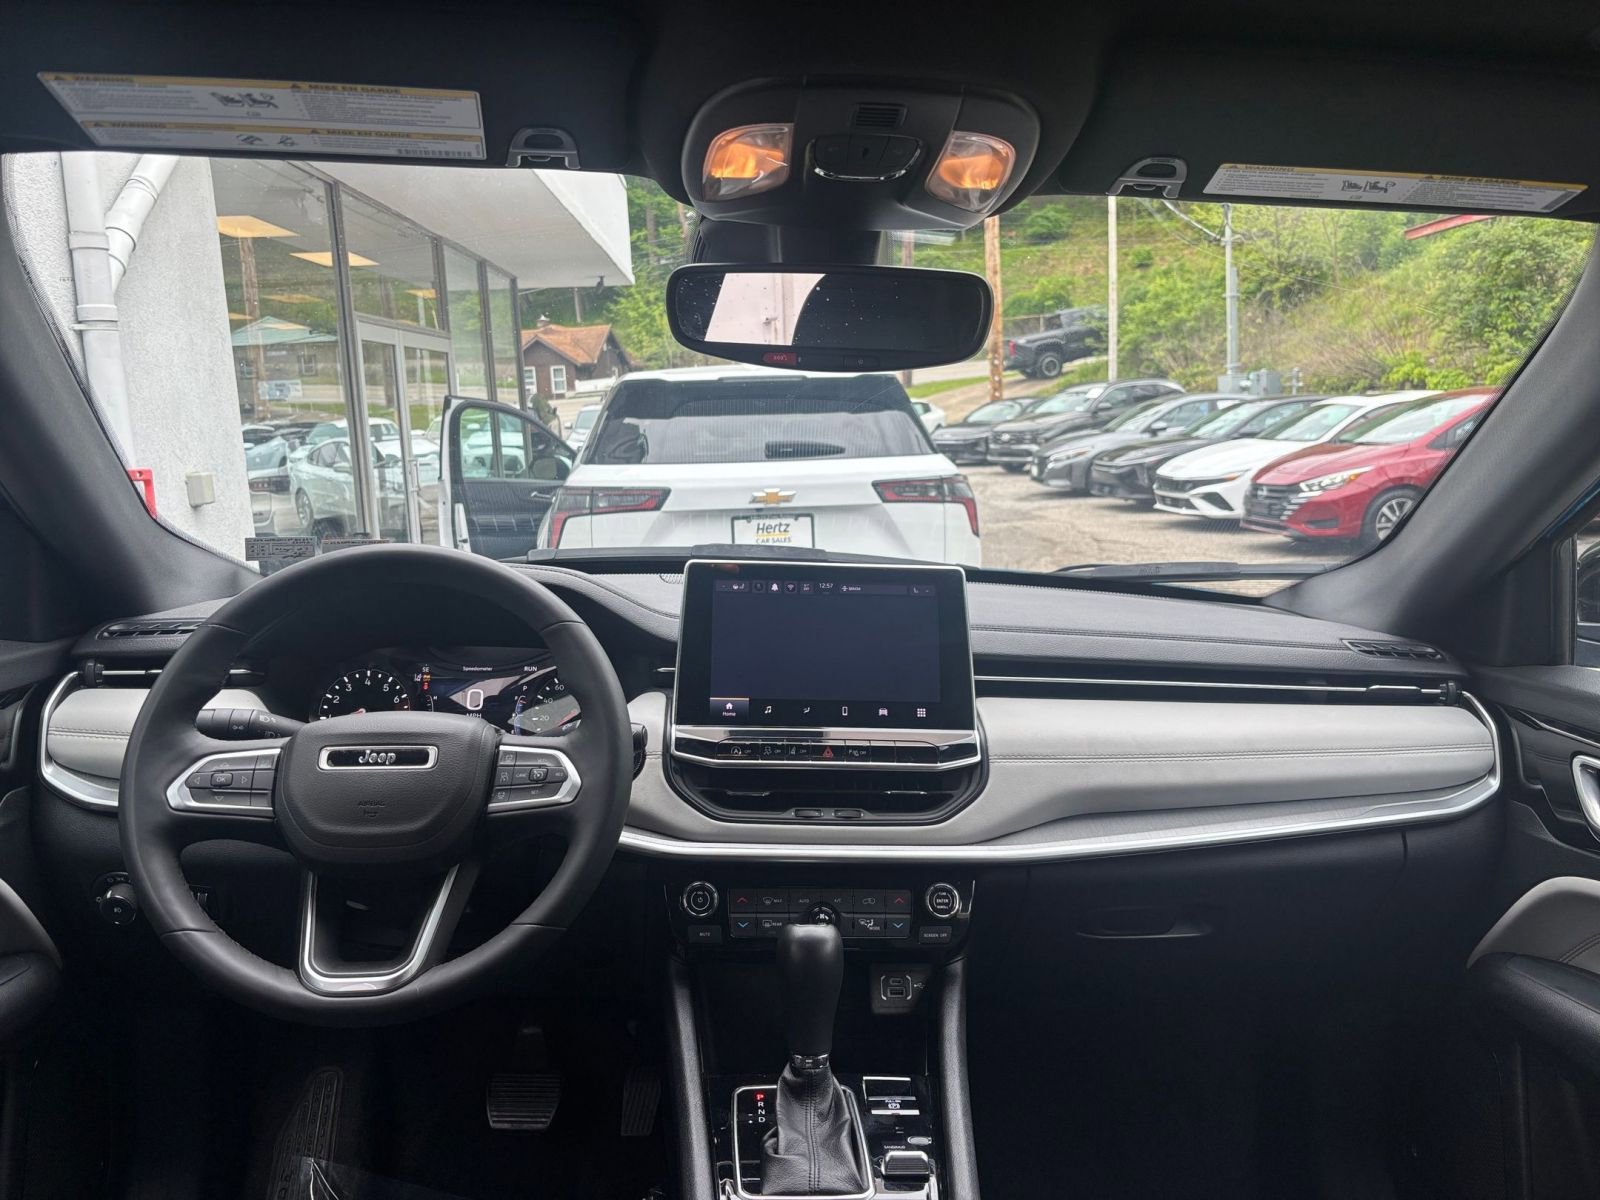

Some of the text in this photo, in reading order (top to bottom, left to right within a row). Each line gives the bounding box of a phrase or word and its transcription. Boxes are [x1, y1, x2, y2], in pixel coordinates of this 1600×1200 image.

[756, 522, 791, 534] Hertz
[364, 678, 371, 686] 4
[345, 684, 352, 692] 3
[383, 684, 390, 692] 5
[333, 695, 340, 703] 2
[393, 696, 400, 704] 6
[466, 689, 484, 710] 0
[358, 749, 396, 765] Jeep
